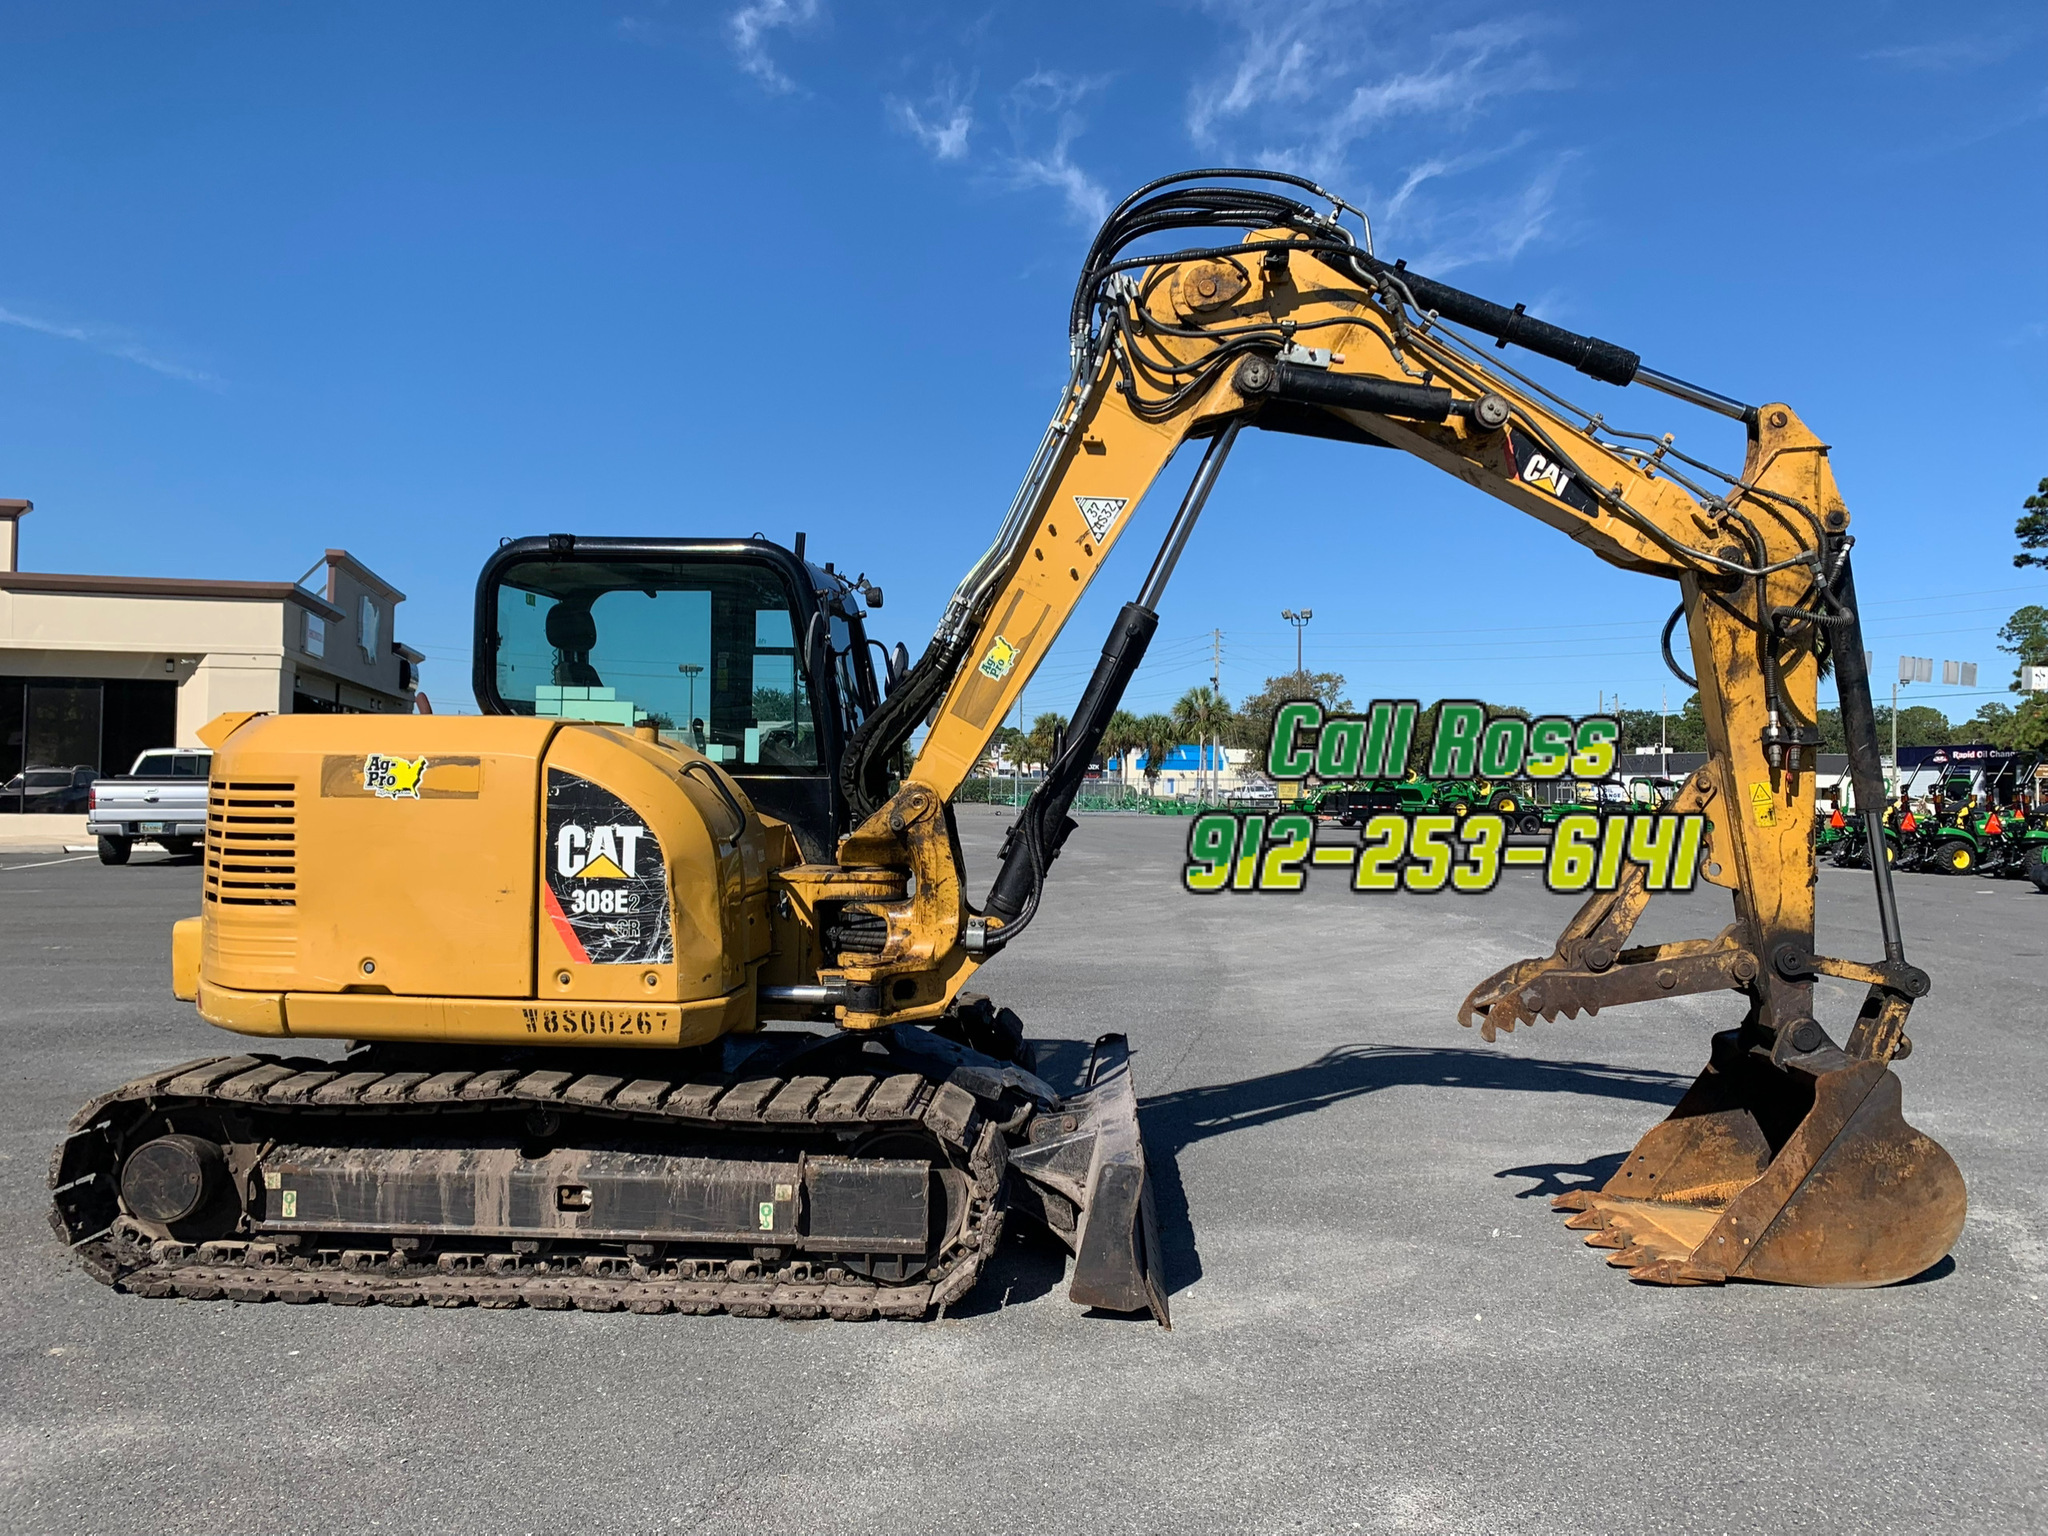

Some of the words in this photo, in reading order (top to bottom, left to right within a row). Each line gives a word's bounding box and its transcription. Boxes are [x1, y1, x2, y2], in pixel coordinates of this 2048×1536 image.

[1523, 454, 1576, 497] CAT
[1952, 750, 1976, 760] Rapid
[1976, 750, 1988, 758] Oil
[367, 756, 397, 775] Ag-
[366, 771, 396, 787] Pro
[557, 824, 644, 878] CAT
